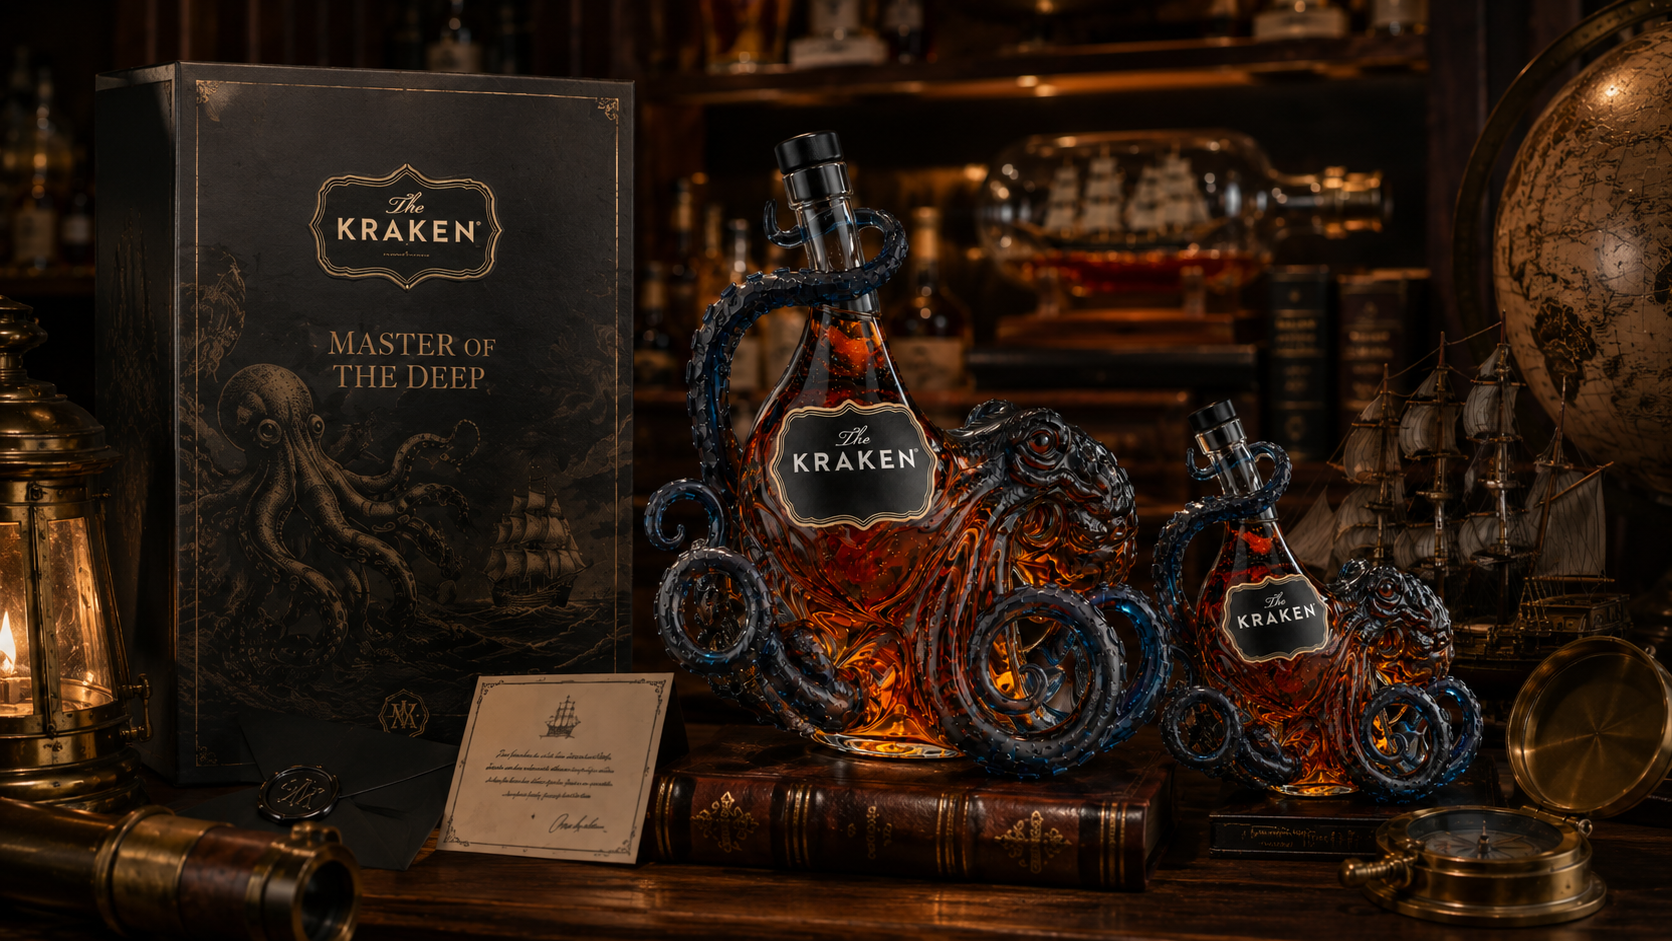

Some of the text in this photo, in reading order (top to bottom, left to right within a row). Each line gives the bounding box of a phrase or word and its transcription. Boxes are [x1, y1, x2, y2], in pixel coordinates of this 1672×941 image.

[386, 191, 425, 214] The
[327, 330, 496, 357] MASTER OF
[332, 364, 485, 390] THE DEEP
[835, 425, 871, 447] The
[1264, 591, 1286, 609] The
